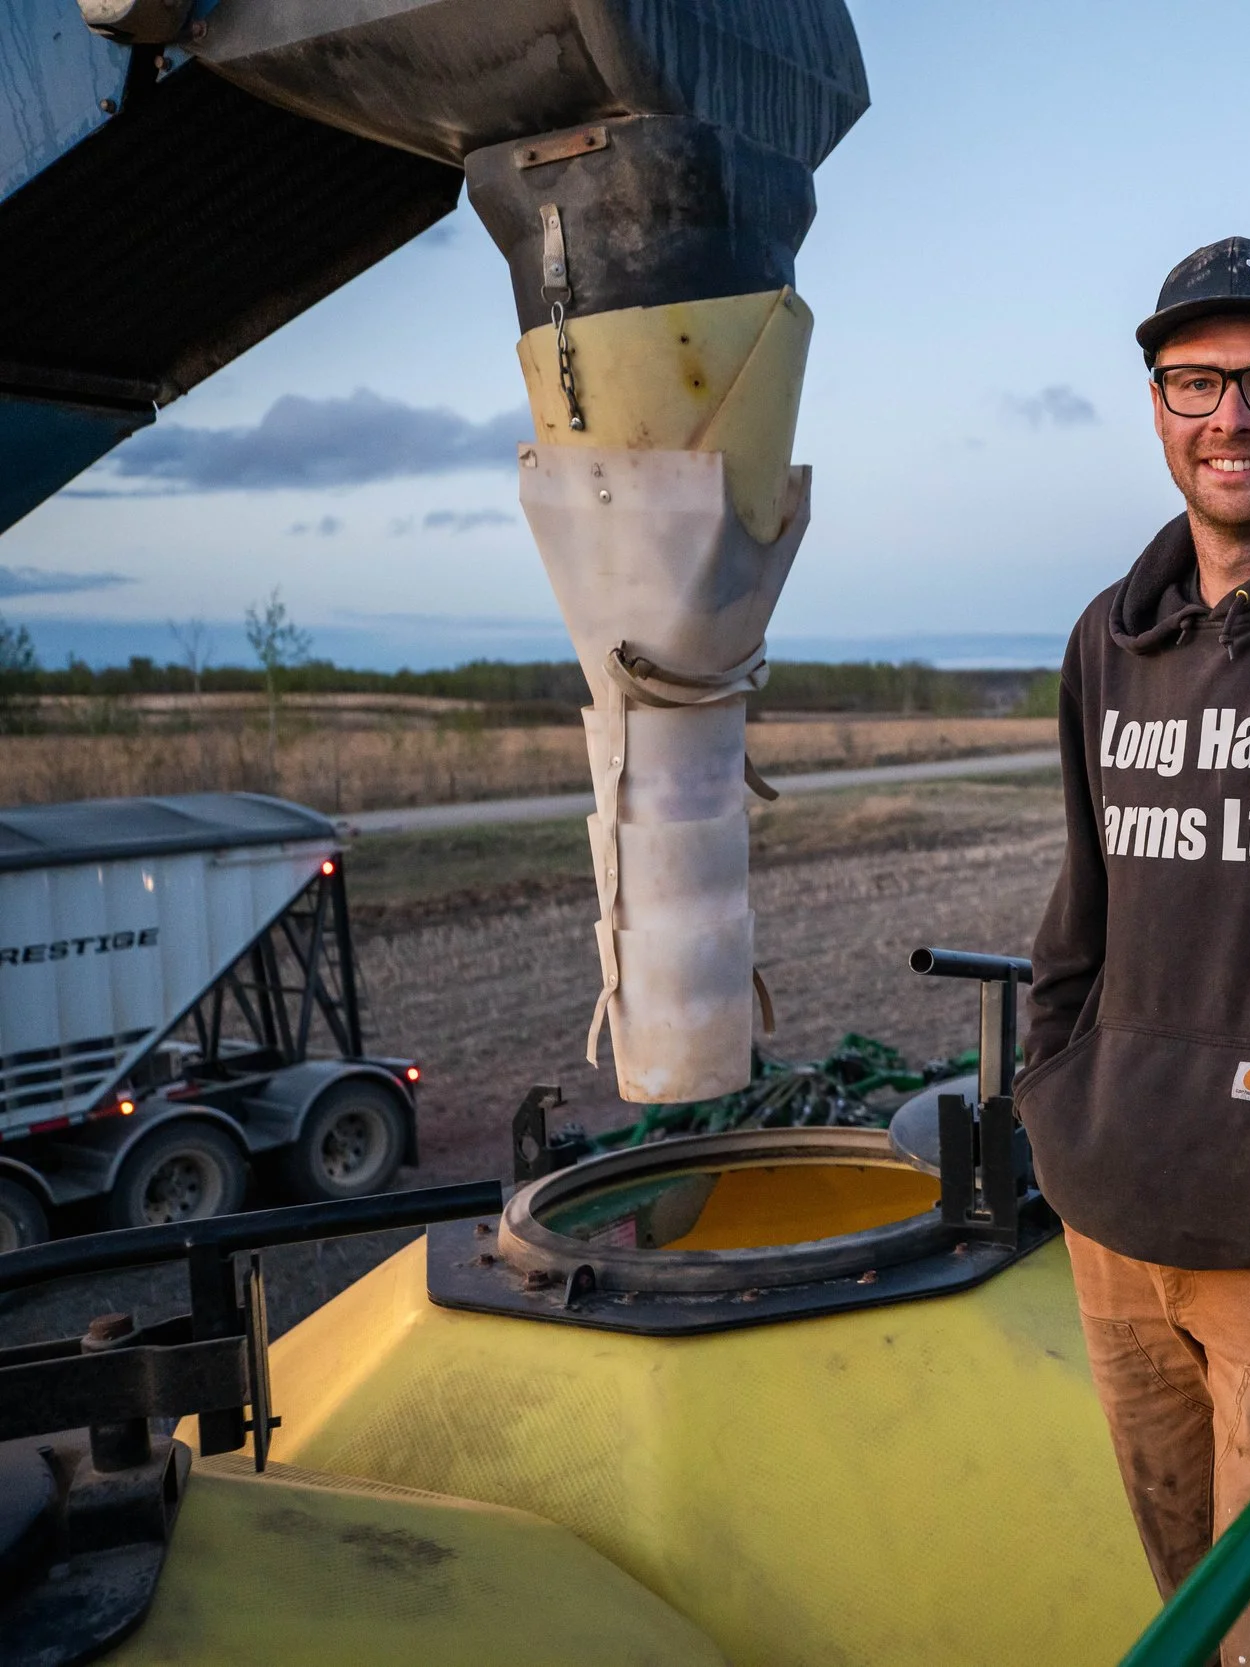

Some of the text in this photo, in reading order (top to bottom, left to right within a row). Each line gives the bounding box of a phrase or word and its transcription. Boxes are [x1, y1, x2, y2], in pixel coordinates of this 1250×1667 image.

[1100, 709, 1187, 777] Long
[1102, 796, 1207, 861] arms
[0, 927, 160, 967] RESTIGE
